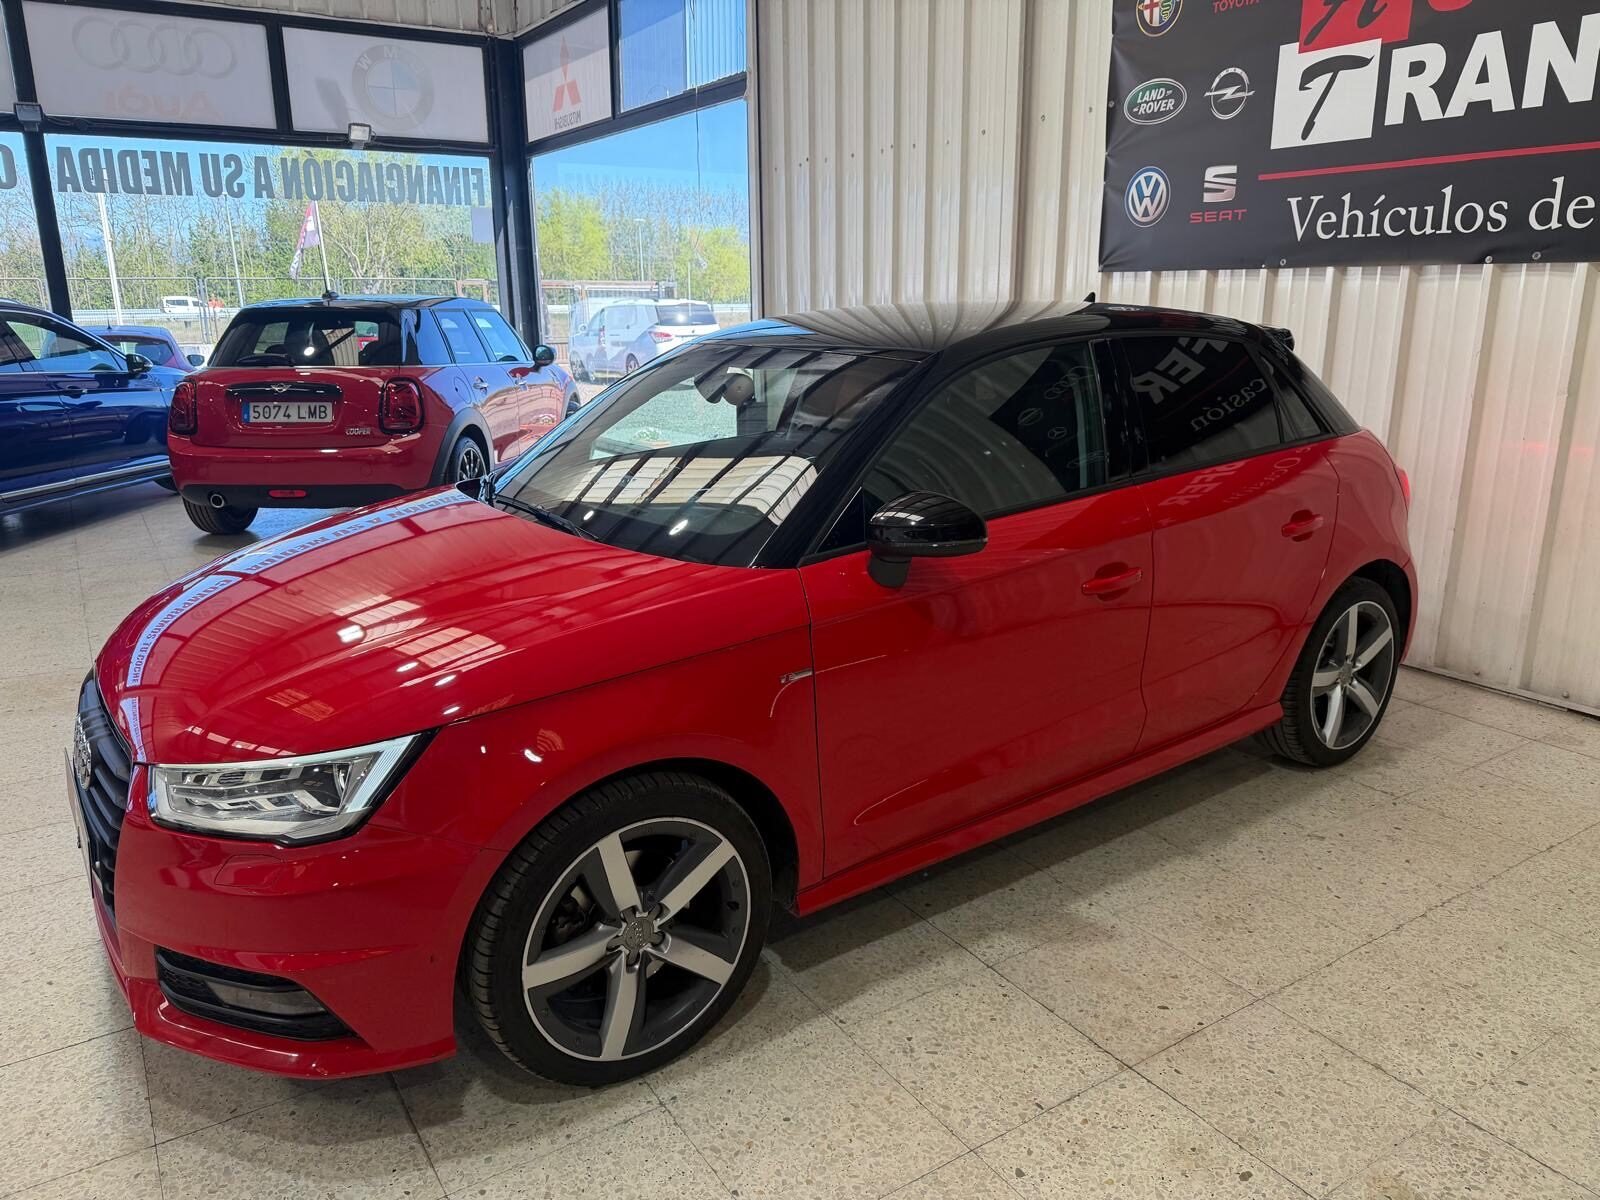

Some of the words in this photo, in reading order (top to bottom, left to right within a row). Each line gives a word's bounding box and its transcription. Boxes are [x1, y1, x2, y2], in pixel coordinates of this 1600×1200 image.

[1137, 87, 1165, 103] LAND
[1138, 98, 1175, 115] ROVER
[1190, 209, 1247, 224] SEAT
[1287, 184, 1509, 242] Vehículos
[1528, 175, 1596, 231] de
[252, 404, 292, 420] 5074
[297, 404, 328, 420] LMB
